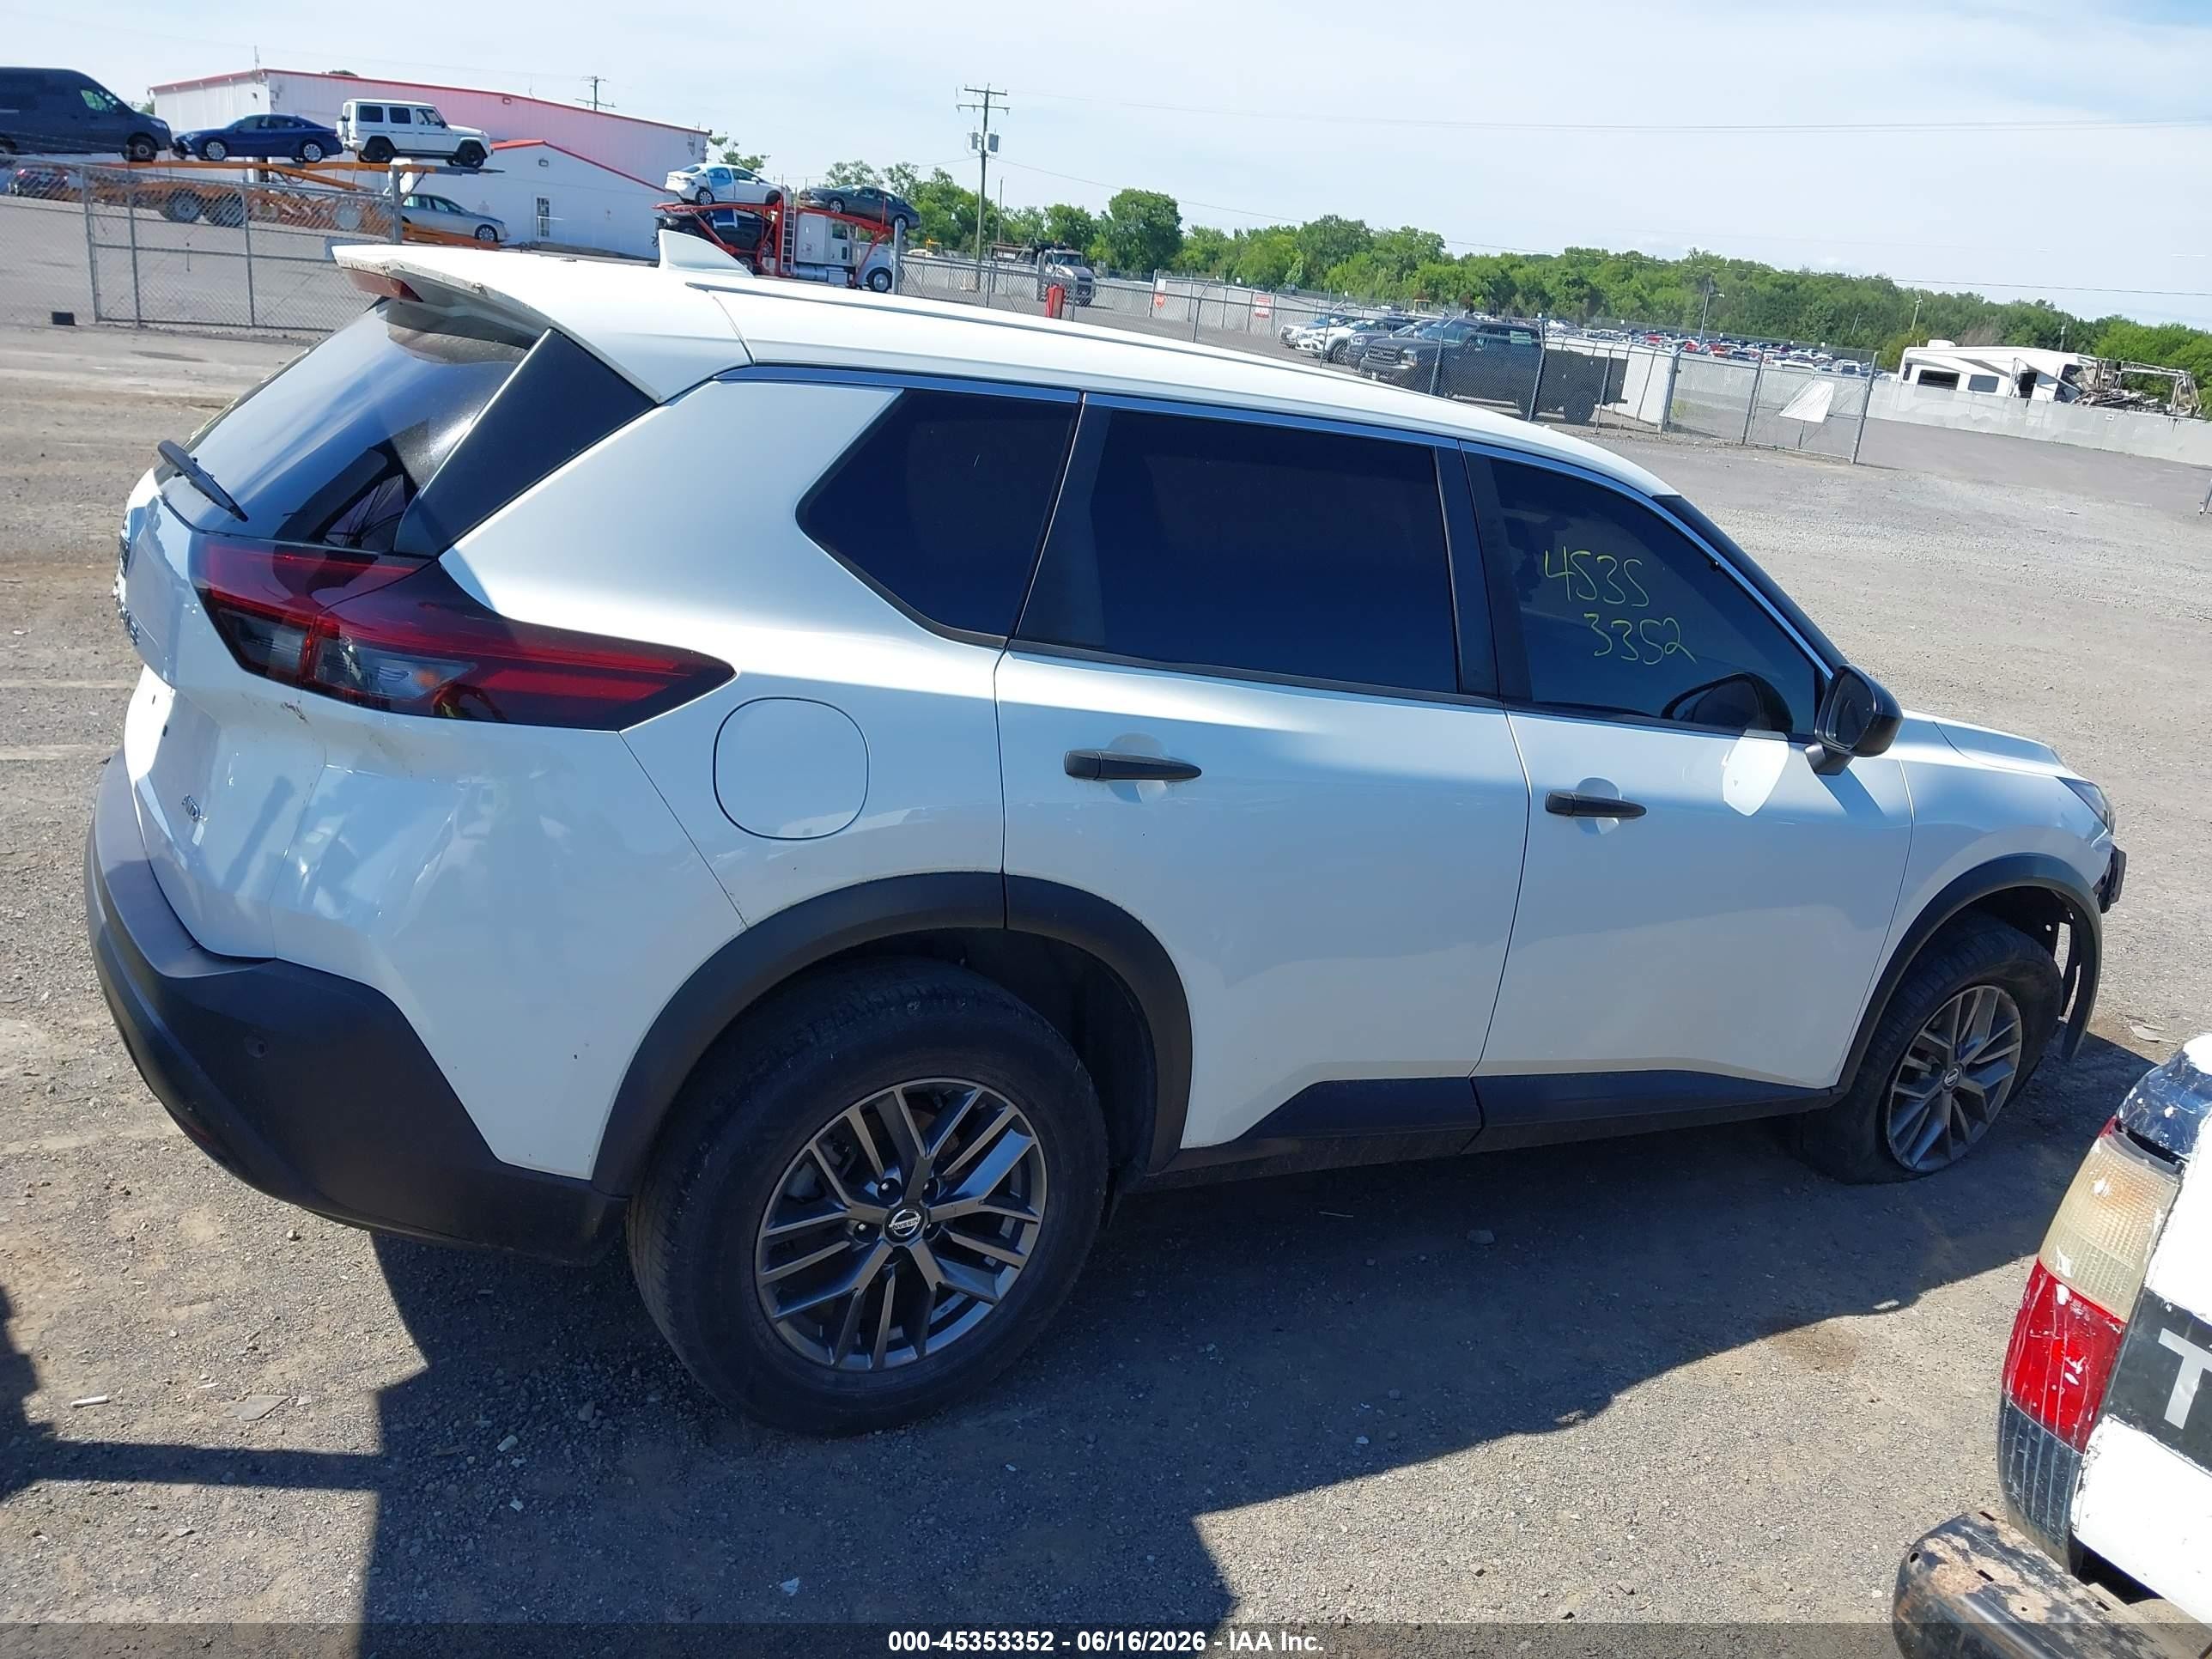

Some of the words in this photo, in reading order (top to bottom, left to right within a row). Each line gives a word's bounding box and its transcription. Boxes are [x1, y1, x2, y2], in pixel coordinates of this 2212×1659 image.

[1545, 545, 1650, 607] 4535
[1583, 612, 1697, 665] 3352
[891, 1217, 920, 1231] NISSAN
